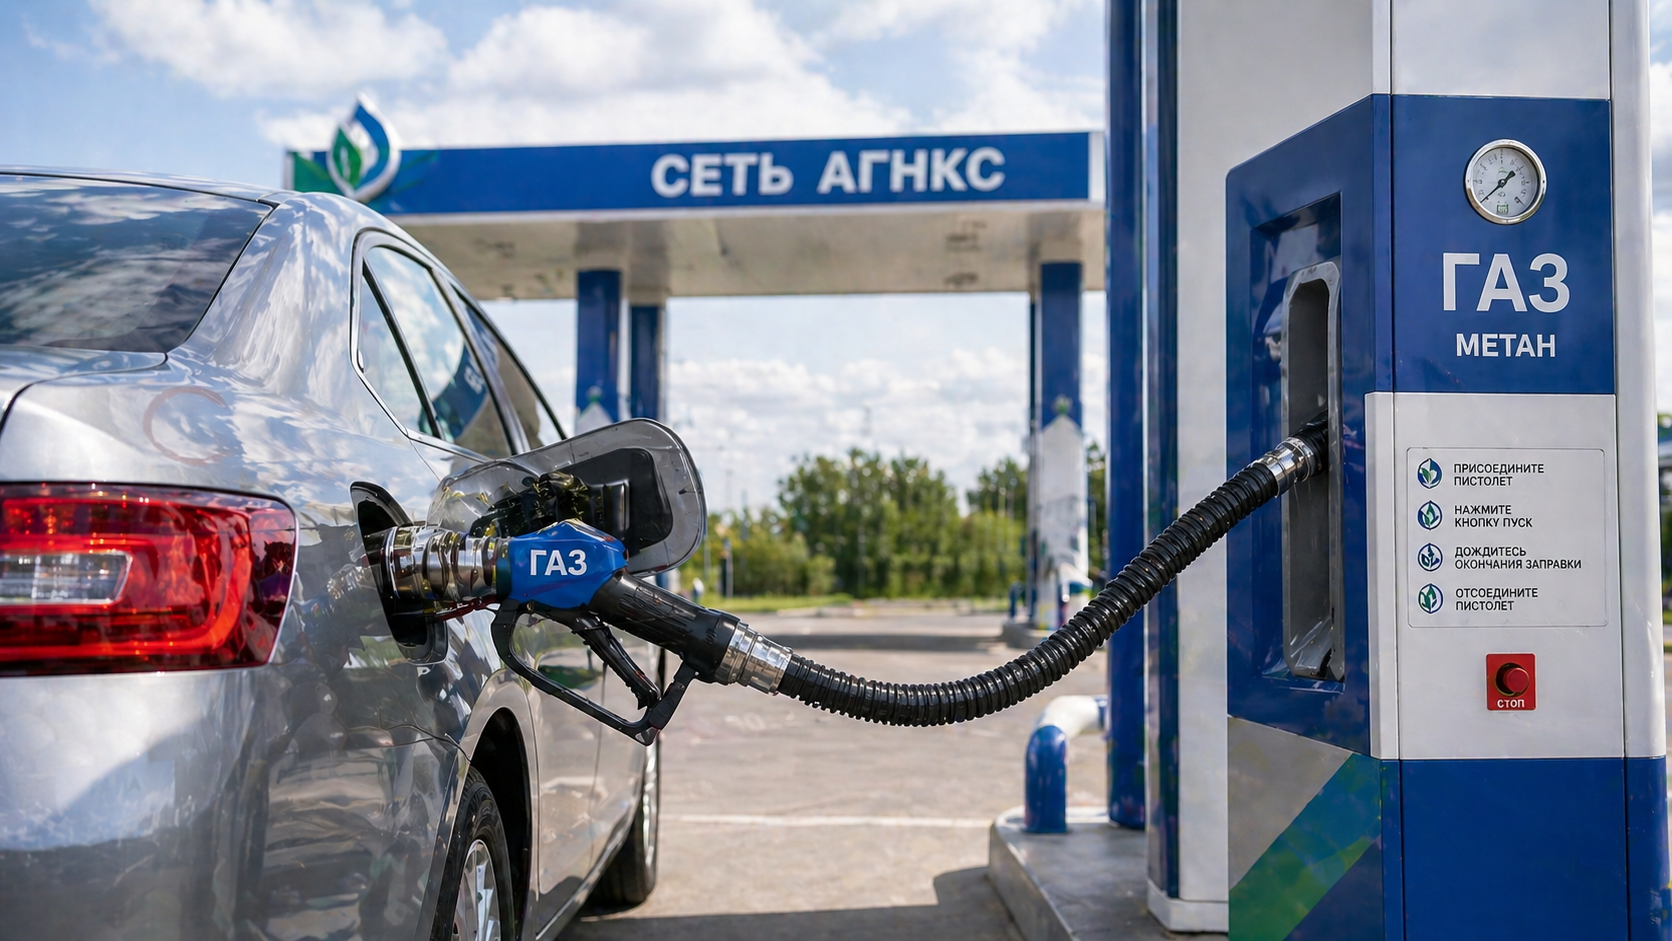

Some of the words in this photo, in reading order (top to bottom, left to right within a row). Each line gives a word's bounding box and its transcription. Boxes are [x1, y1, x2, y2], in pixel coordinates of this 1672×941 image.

[651, 153, 793, 197] СЕТЬ
[818, 147, 1005, 194] АГНКС
[1442, 252, 1570, 313] ГАЗ
[1456, 333, 1556, 358] МЕТАН
[1454, 463, 1545, 475] ПРИСОЕДИНИТЕ
[1454, 476, 1513, 487] ПИСТОЛЕТ
[1454, 504, 1512, 515] НАЖМИТЕ
[1454, 517, 1500, 528] КНОПКУ
[1503, 517, 1533, 528] ПУСК
[1455, 546, 1527, 558] ДОЖДИТЕСЬ
[529, 549, 588, 576] ГАЗ
[1454, 559, 1523, 570] ОКОНЧАНИЯ
[1525, 559, 1582, 570] ЗАПРАВКИ
[1455, 587, 1539, 600] ОТСОЕДИНИТЕ
[1455, 600, 1515, 611] ПИСТОЛЕТ
[1497, 699, 1525, 709] СТОП
